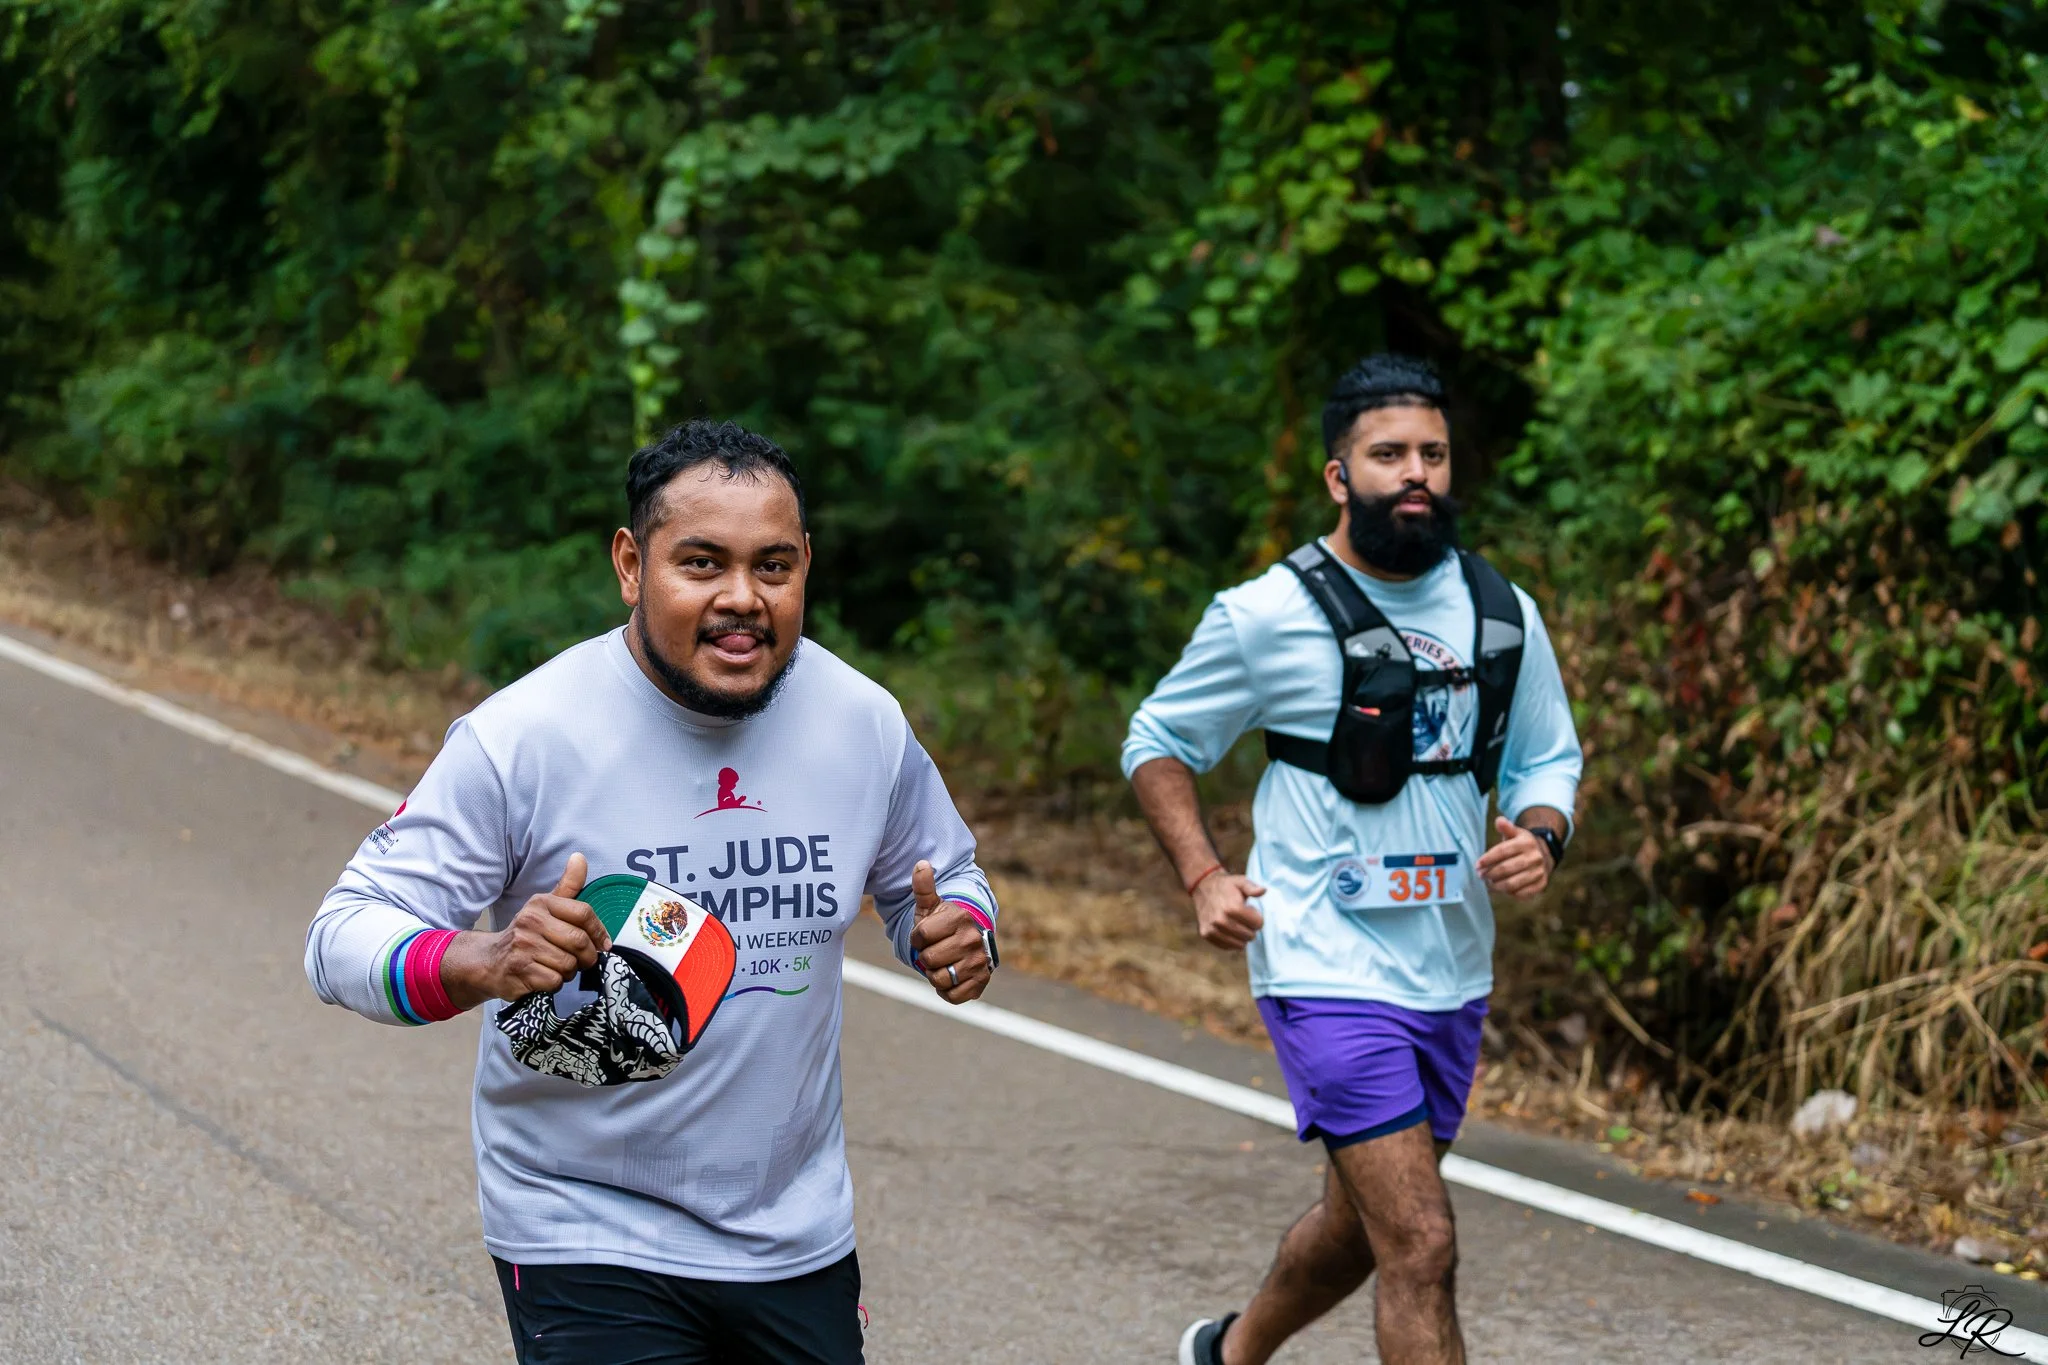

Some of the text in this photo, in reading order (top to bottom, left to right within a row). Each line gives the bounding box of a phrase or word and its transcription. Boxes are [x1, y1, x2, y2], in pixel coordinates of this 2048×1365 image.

[626, 834, 834, 884] ST. JUDE
[1388, 868, 1446, 902] 351
[682, 882, 839, 923] MPHIS
[746, 929, 832, 950] WEEKEND
[750, 955, 812, 976] 10K 5K
